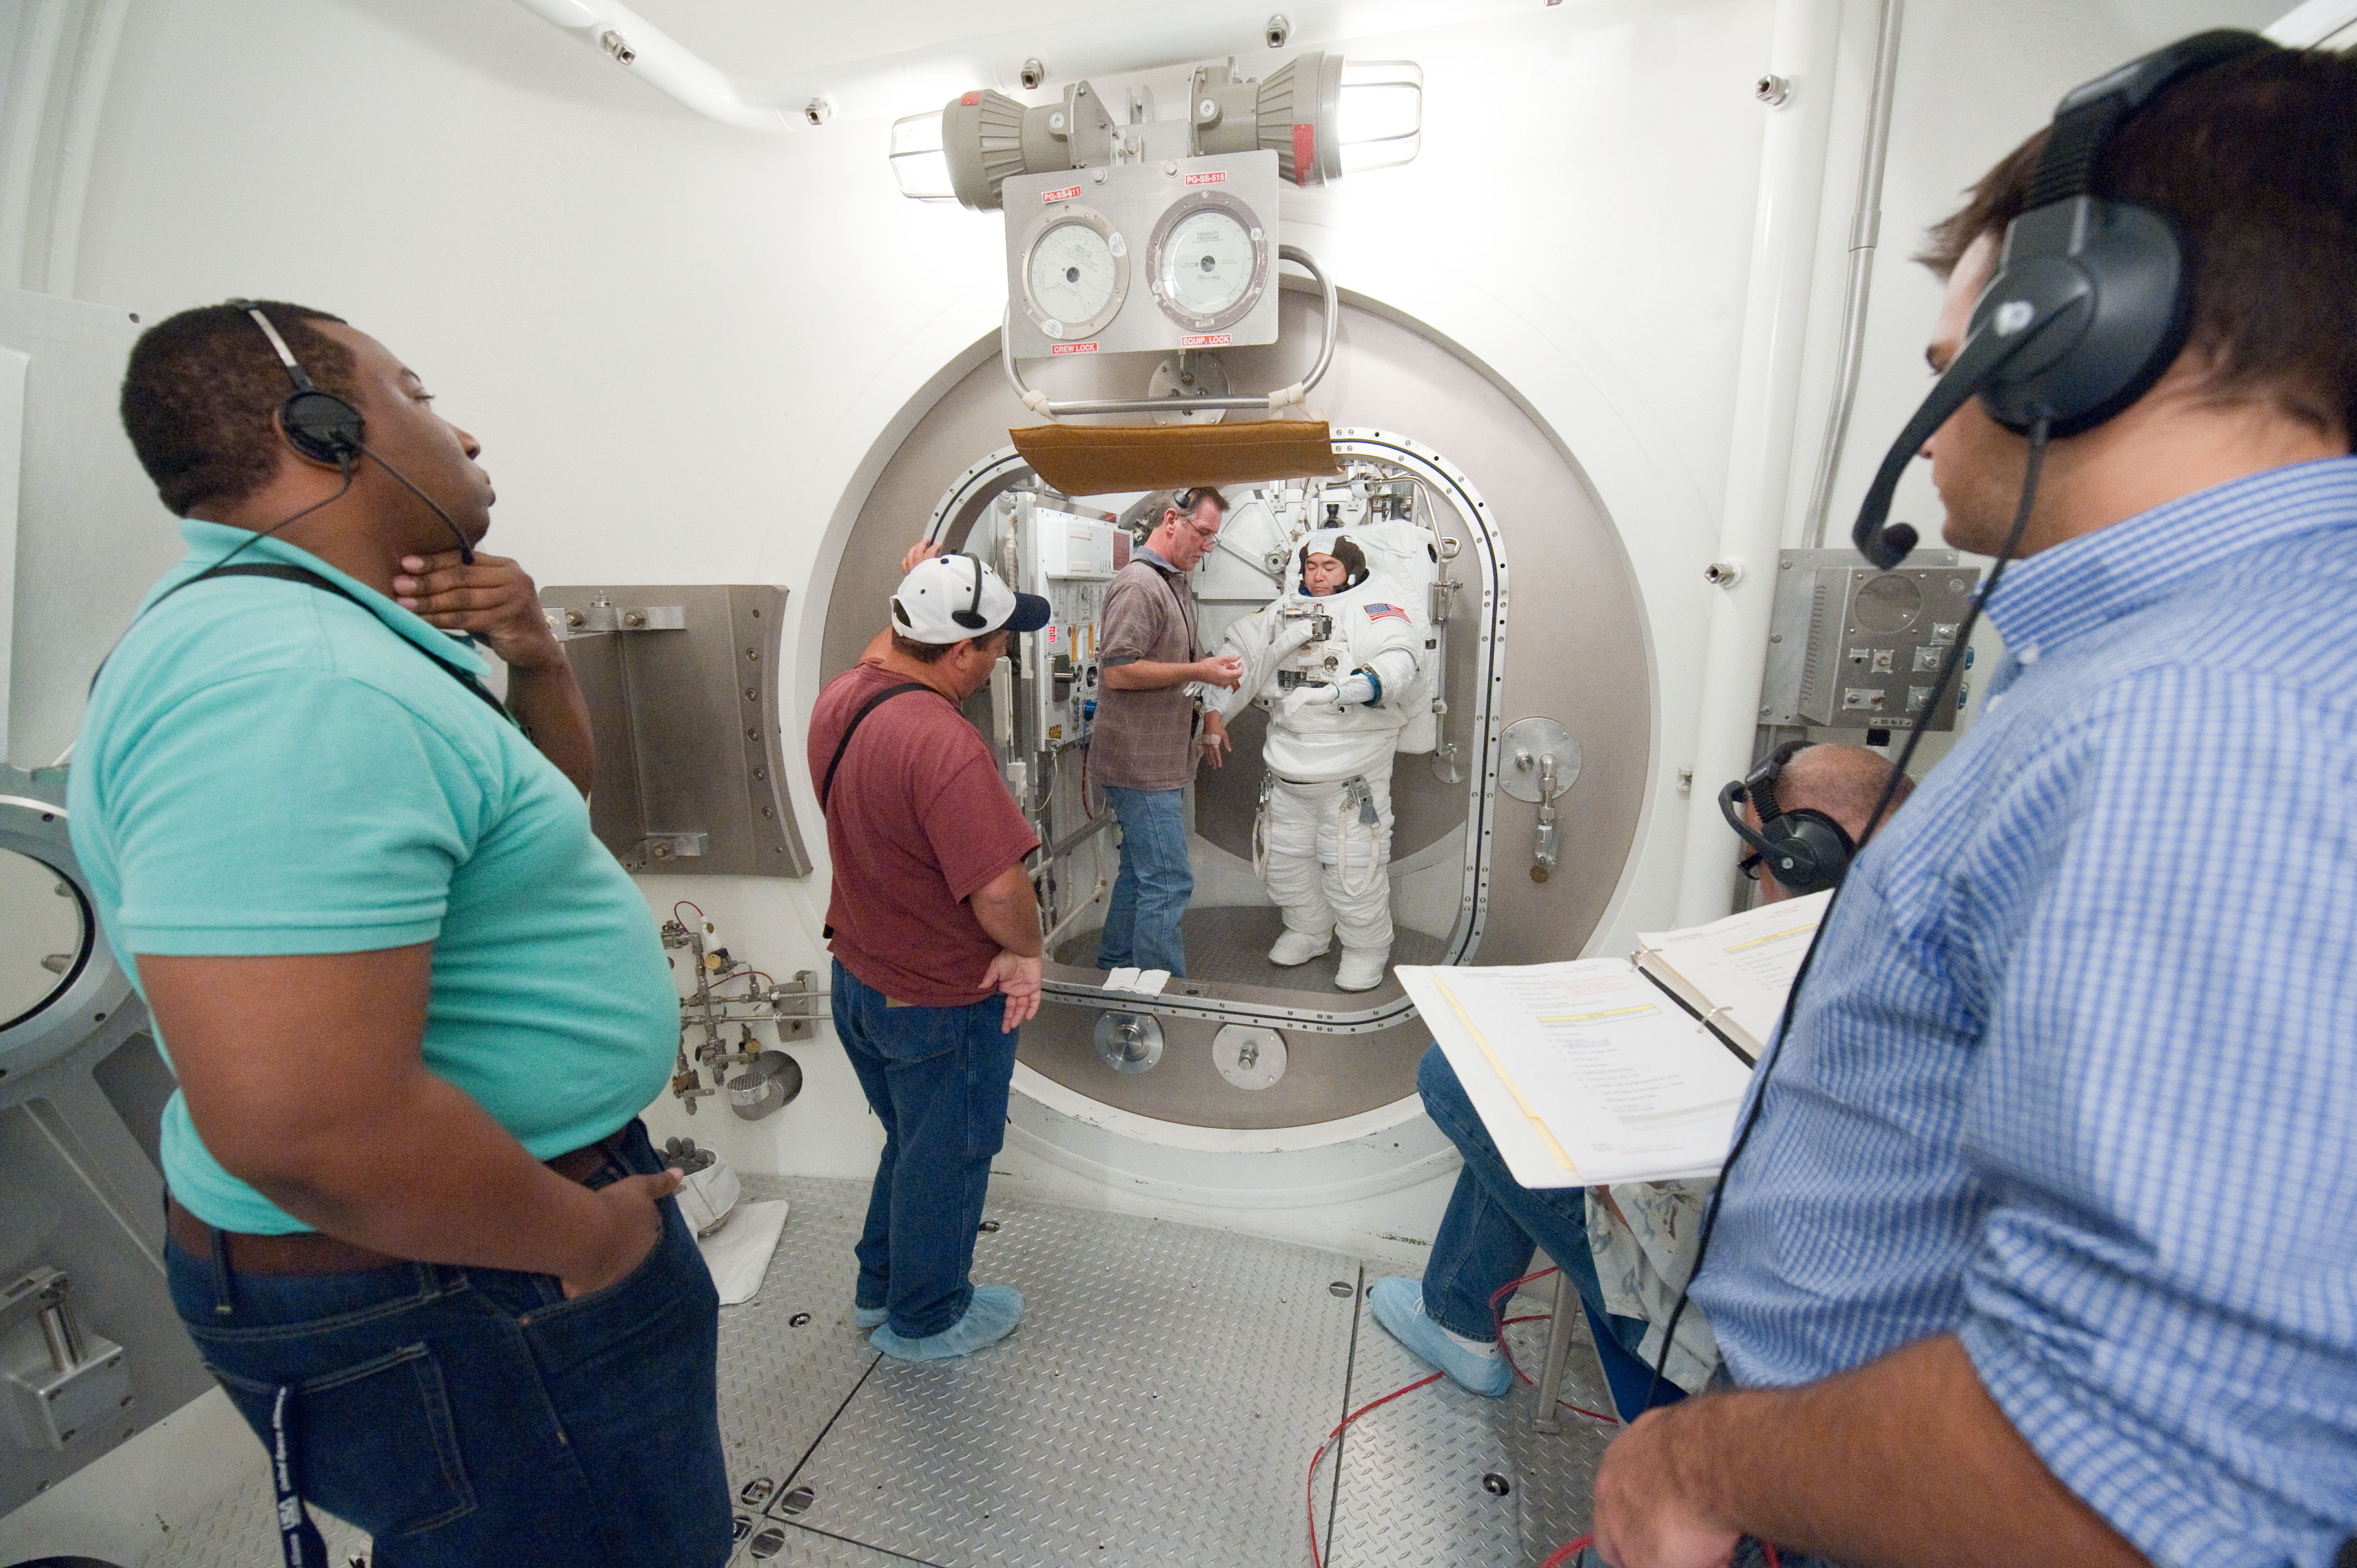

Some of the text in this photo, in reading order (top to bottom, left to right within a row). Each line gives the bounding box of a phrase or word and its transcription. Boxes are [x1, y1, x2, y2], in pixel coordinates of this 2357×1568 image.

[1186, 173, 1224, 184] PG-SS-515
[1182, 335, 1229, 346] EQUIP. LOCK
[1053, 343, 1096, 354] CREW LOCK
